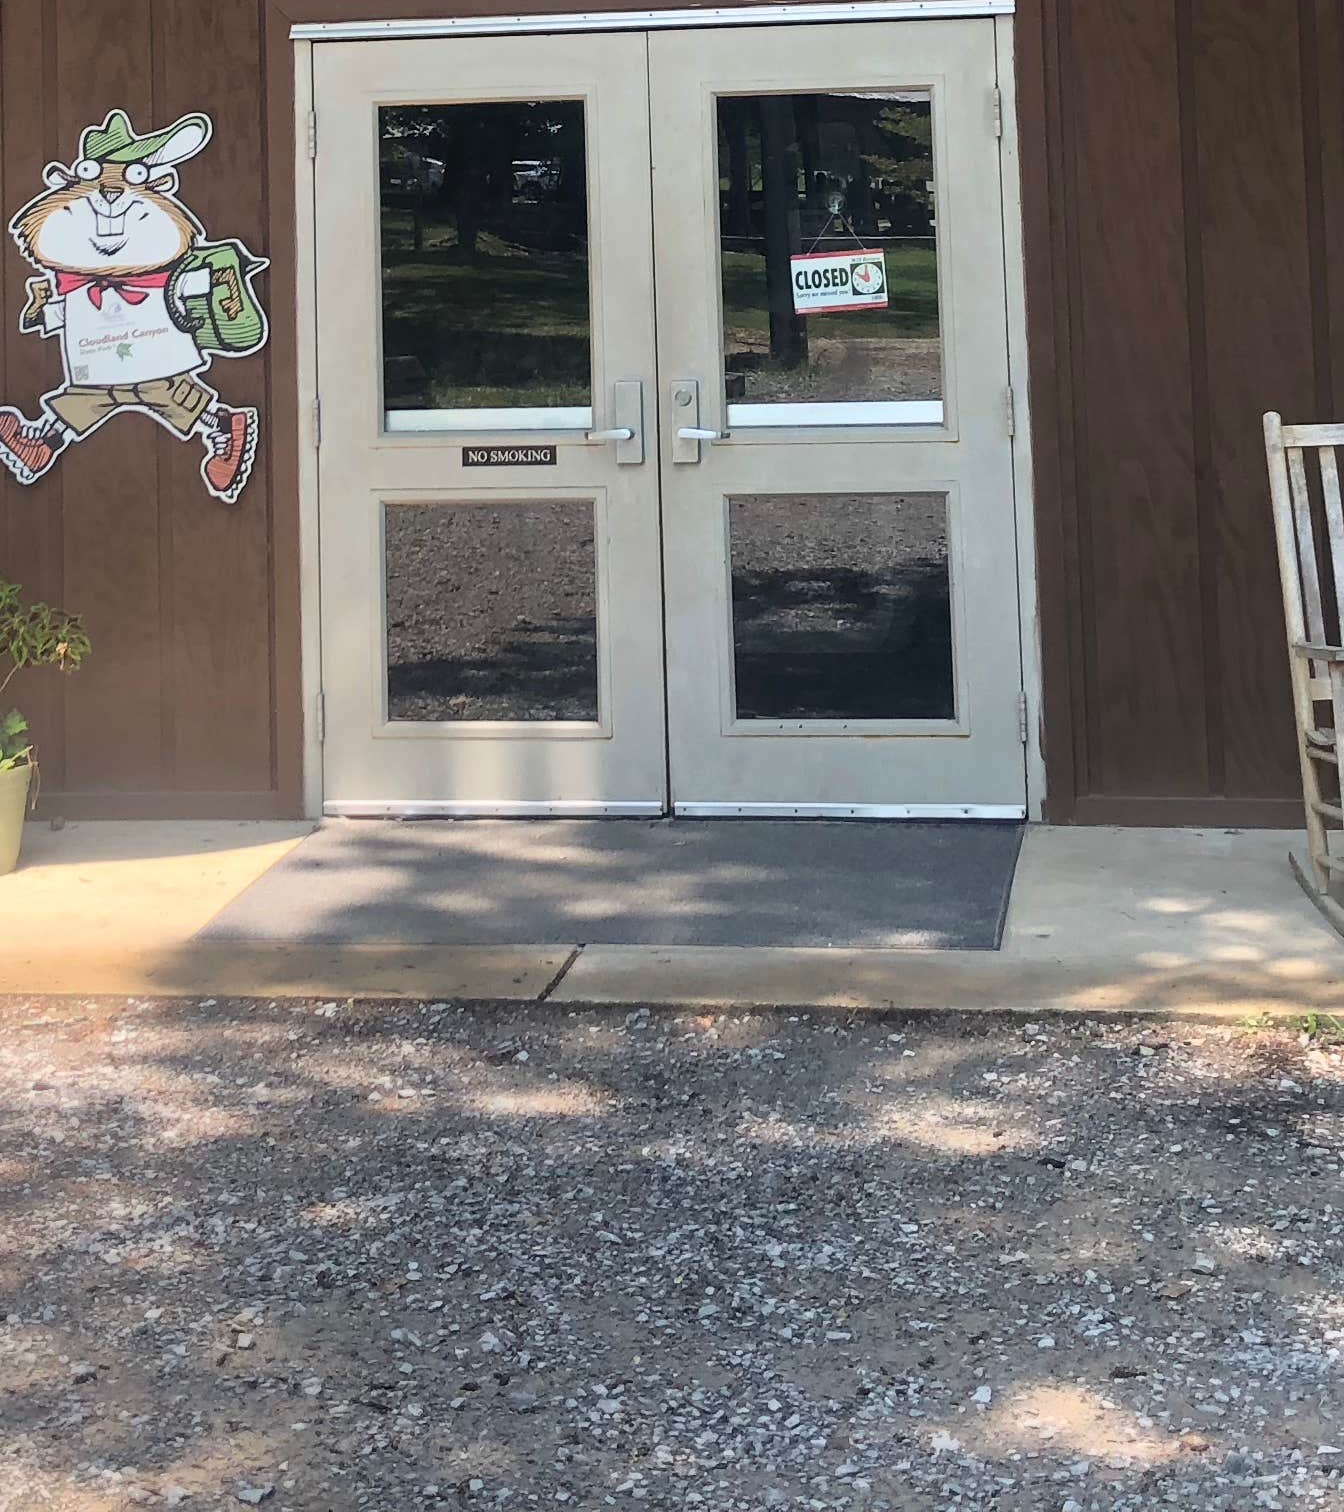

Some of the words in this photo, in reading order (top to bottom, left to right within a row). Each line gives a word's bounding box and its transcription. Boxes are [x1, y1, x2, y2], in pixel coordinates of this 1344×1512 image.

[795, 268, 849, 290] CLOSED
[78, 331, 129, 347] Cloudland
[131, 327, 169, 338] Canyon
[468, 450, 488, 463] NO
[490, 449, 551, 462] SMOKING
